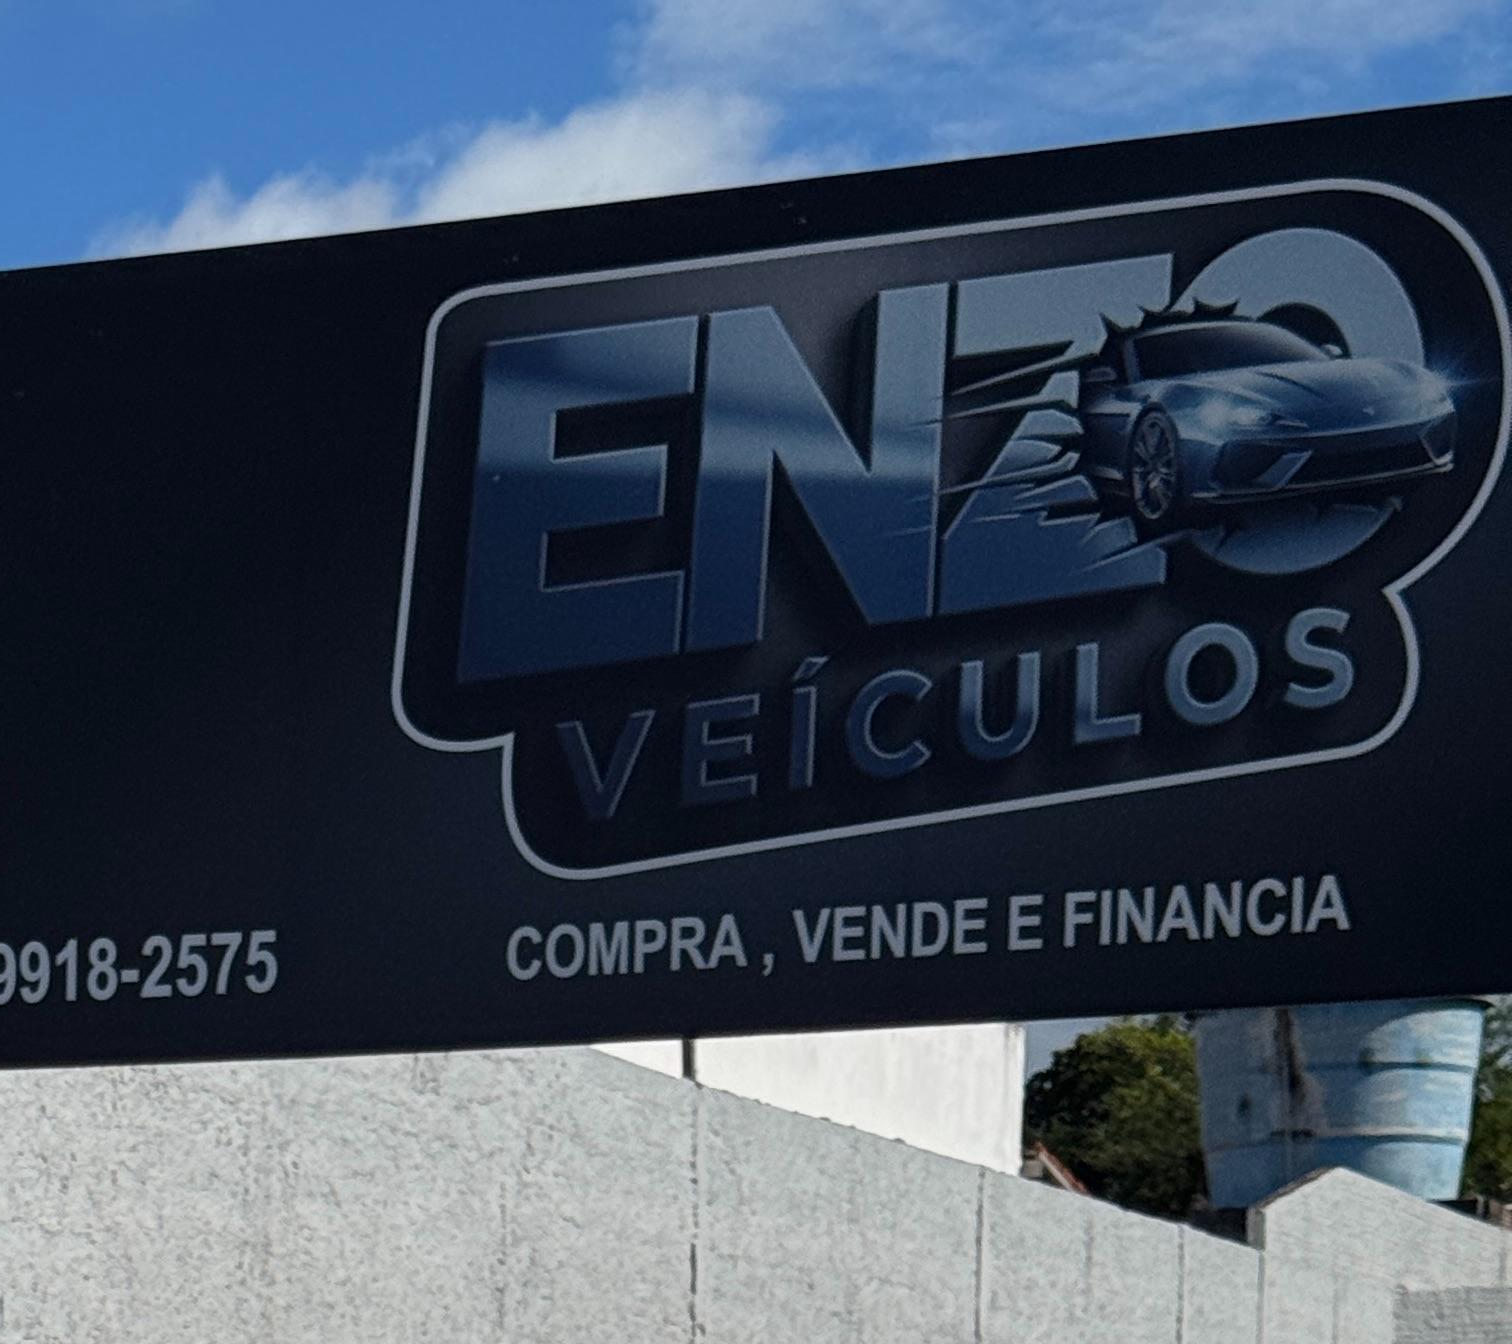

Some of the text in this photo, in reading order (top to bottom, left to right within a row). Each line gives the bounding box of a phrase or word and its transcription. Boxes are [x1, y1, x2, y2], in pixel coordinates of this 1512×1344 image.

[456, 227, 1425, 683] ENZO
[555, 607, 1355, 820] VEÍCULOS
[506, 914, 749, 981] COMPRA
[793, 898, 988, 964] VENDE
[1007, 894, 1045, 952] E
[1065, 874, 1352, 948] FINANCIA
